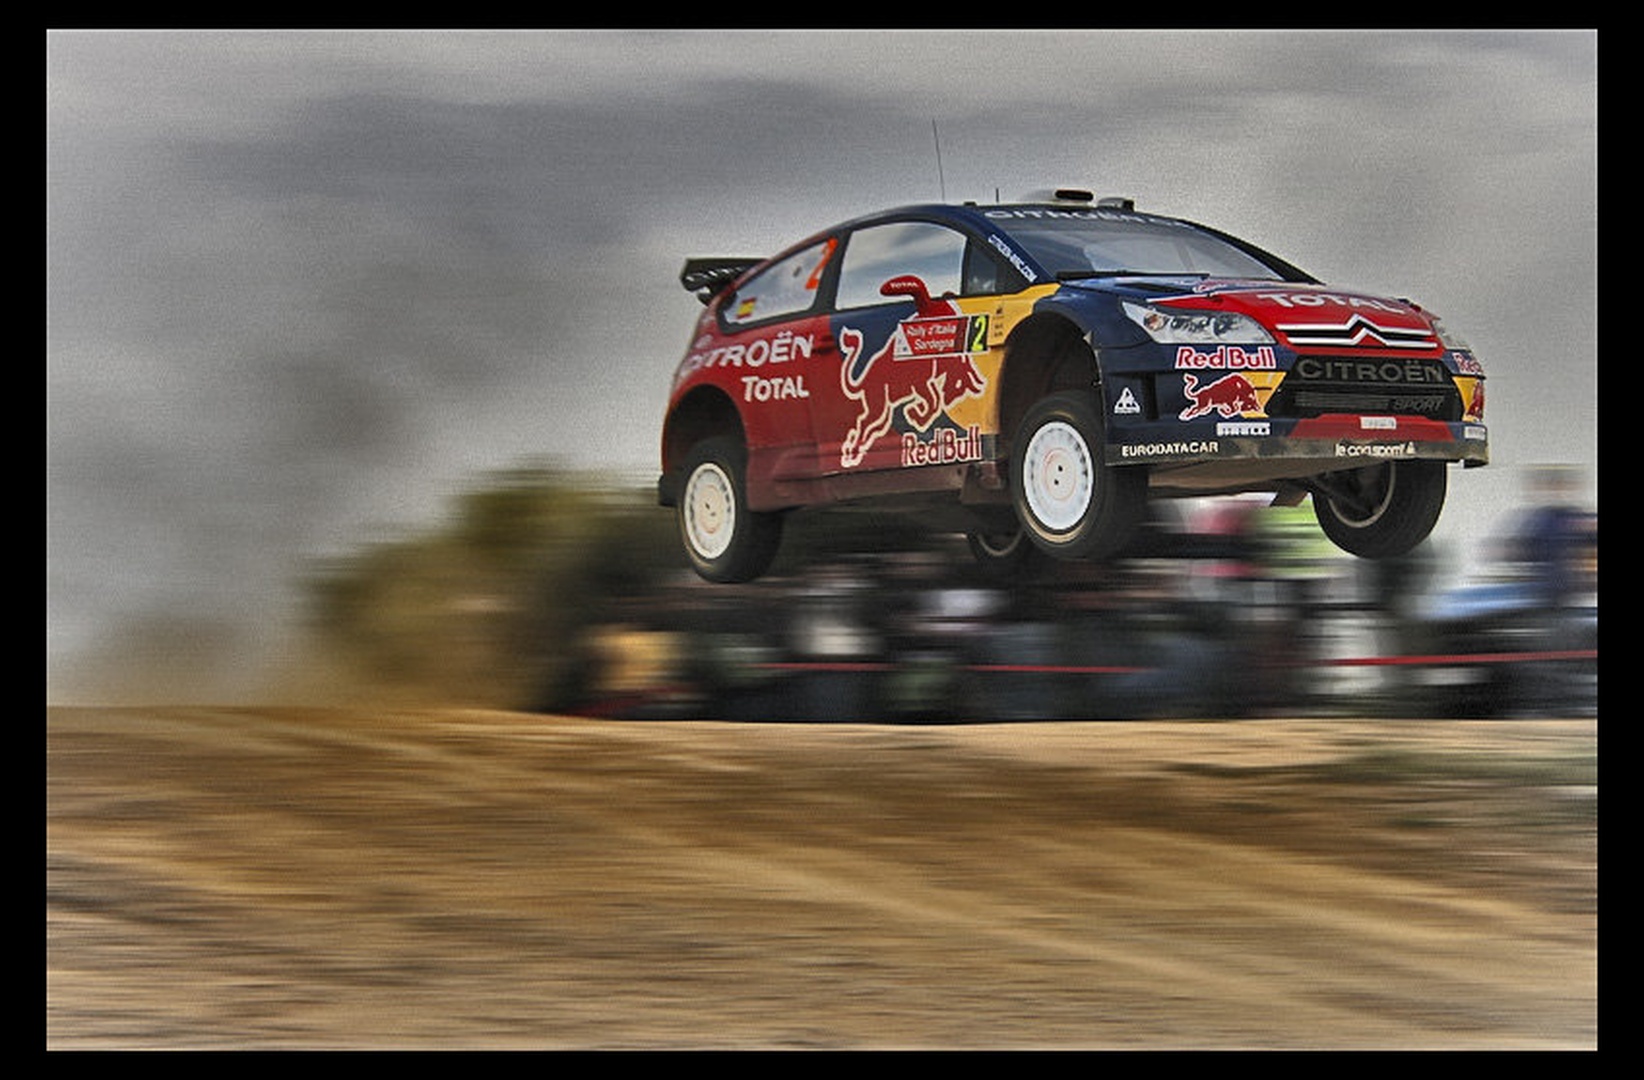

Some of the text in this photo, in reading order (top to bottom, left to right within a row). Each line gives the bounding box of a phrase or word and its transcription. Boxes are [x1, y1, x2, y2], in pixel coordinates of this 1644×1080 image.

[1256, 292, 1406, 315] TOTAL
[971, 314, 987, 352] 2
[1175, 346, 1277, 369] Red Bull
[1297, 359, 1444, 382] CITROËN
[741, 375, 810, 402] TOTAL
[902, 425, 982, 466] Red Bull
[1121, 441, 1219, 457] EURODATACAR
